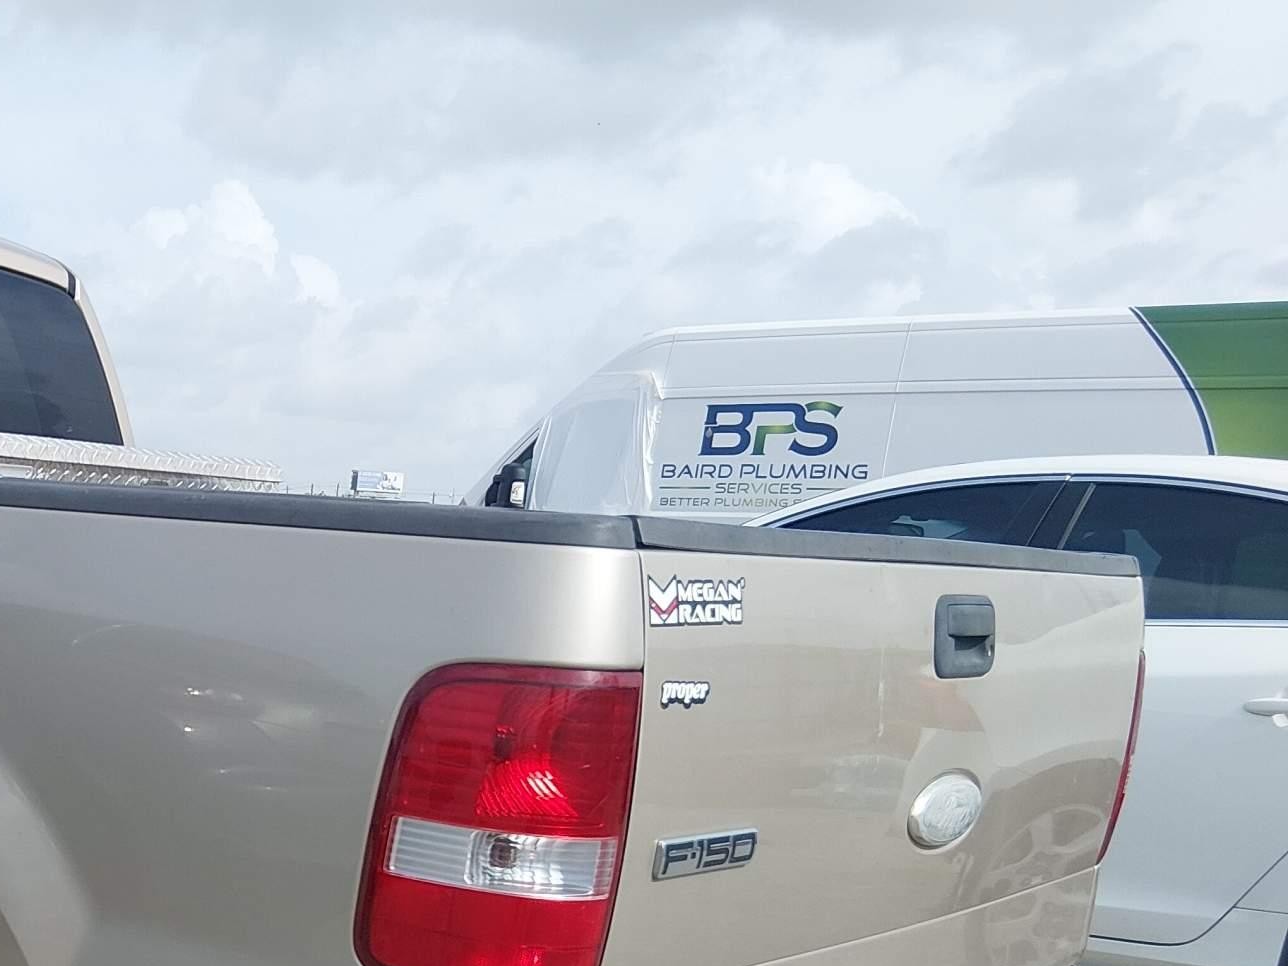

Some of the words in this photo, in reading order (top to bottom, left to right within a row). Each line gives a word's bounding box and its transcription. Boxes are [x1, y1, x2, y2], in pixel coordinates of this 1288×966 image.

[698, 401, 844, 456] BPS
[661, 464, 733, 479] BAIRD
[739, 464, 869, 480] PLUMBING
[714, 482, 803, 495] SERVICES
[659, 497, 710, 507] BETTER
[714, 498, 789, 508] PLUMBING
[677, 581, 742, 602] MEGAN
[678, 603, 743, 623] RACING
[661, 682, 710, 704] proper
